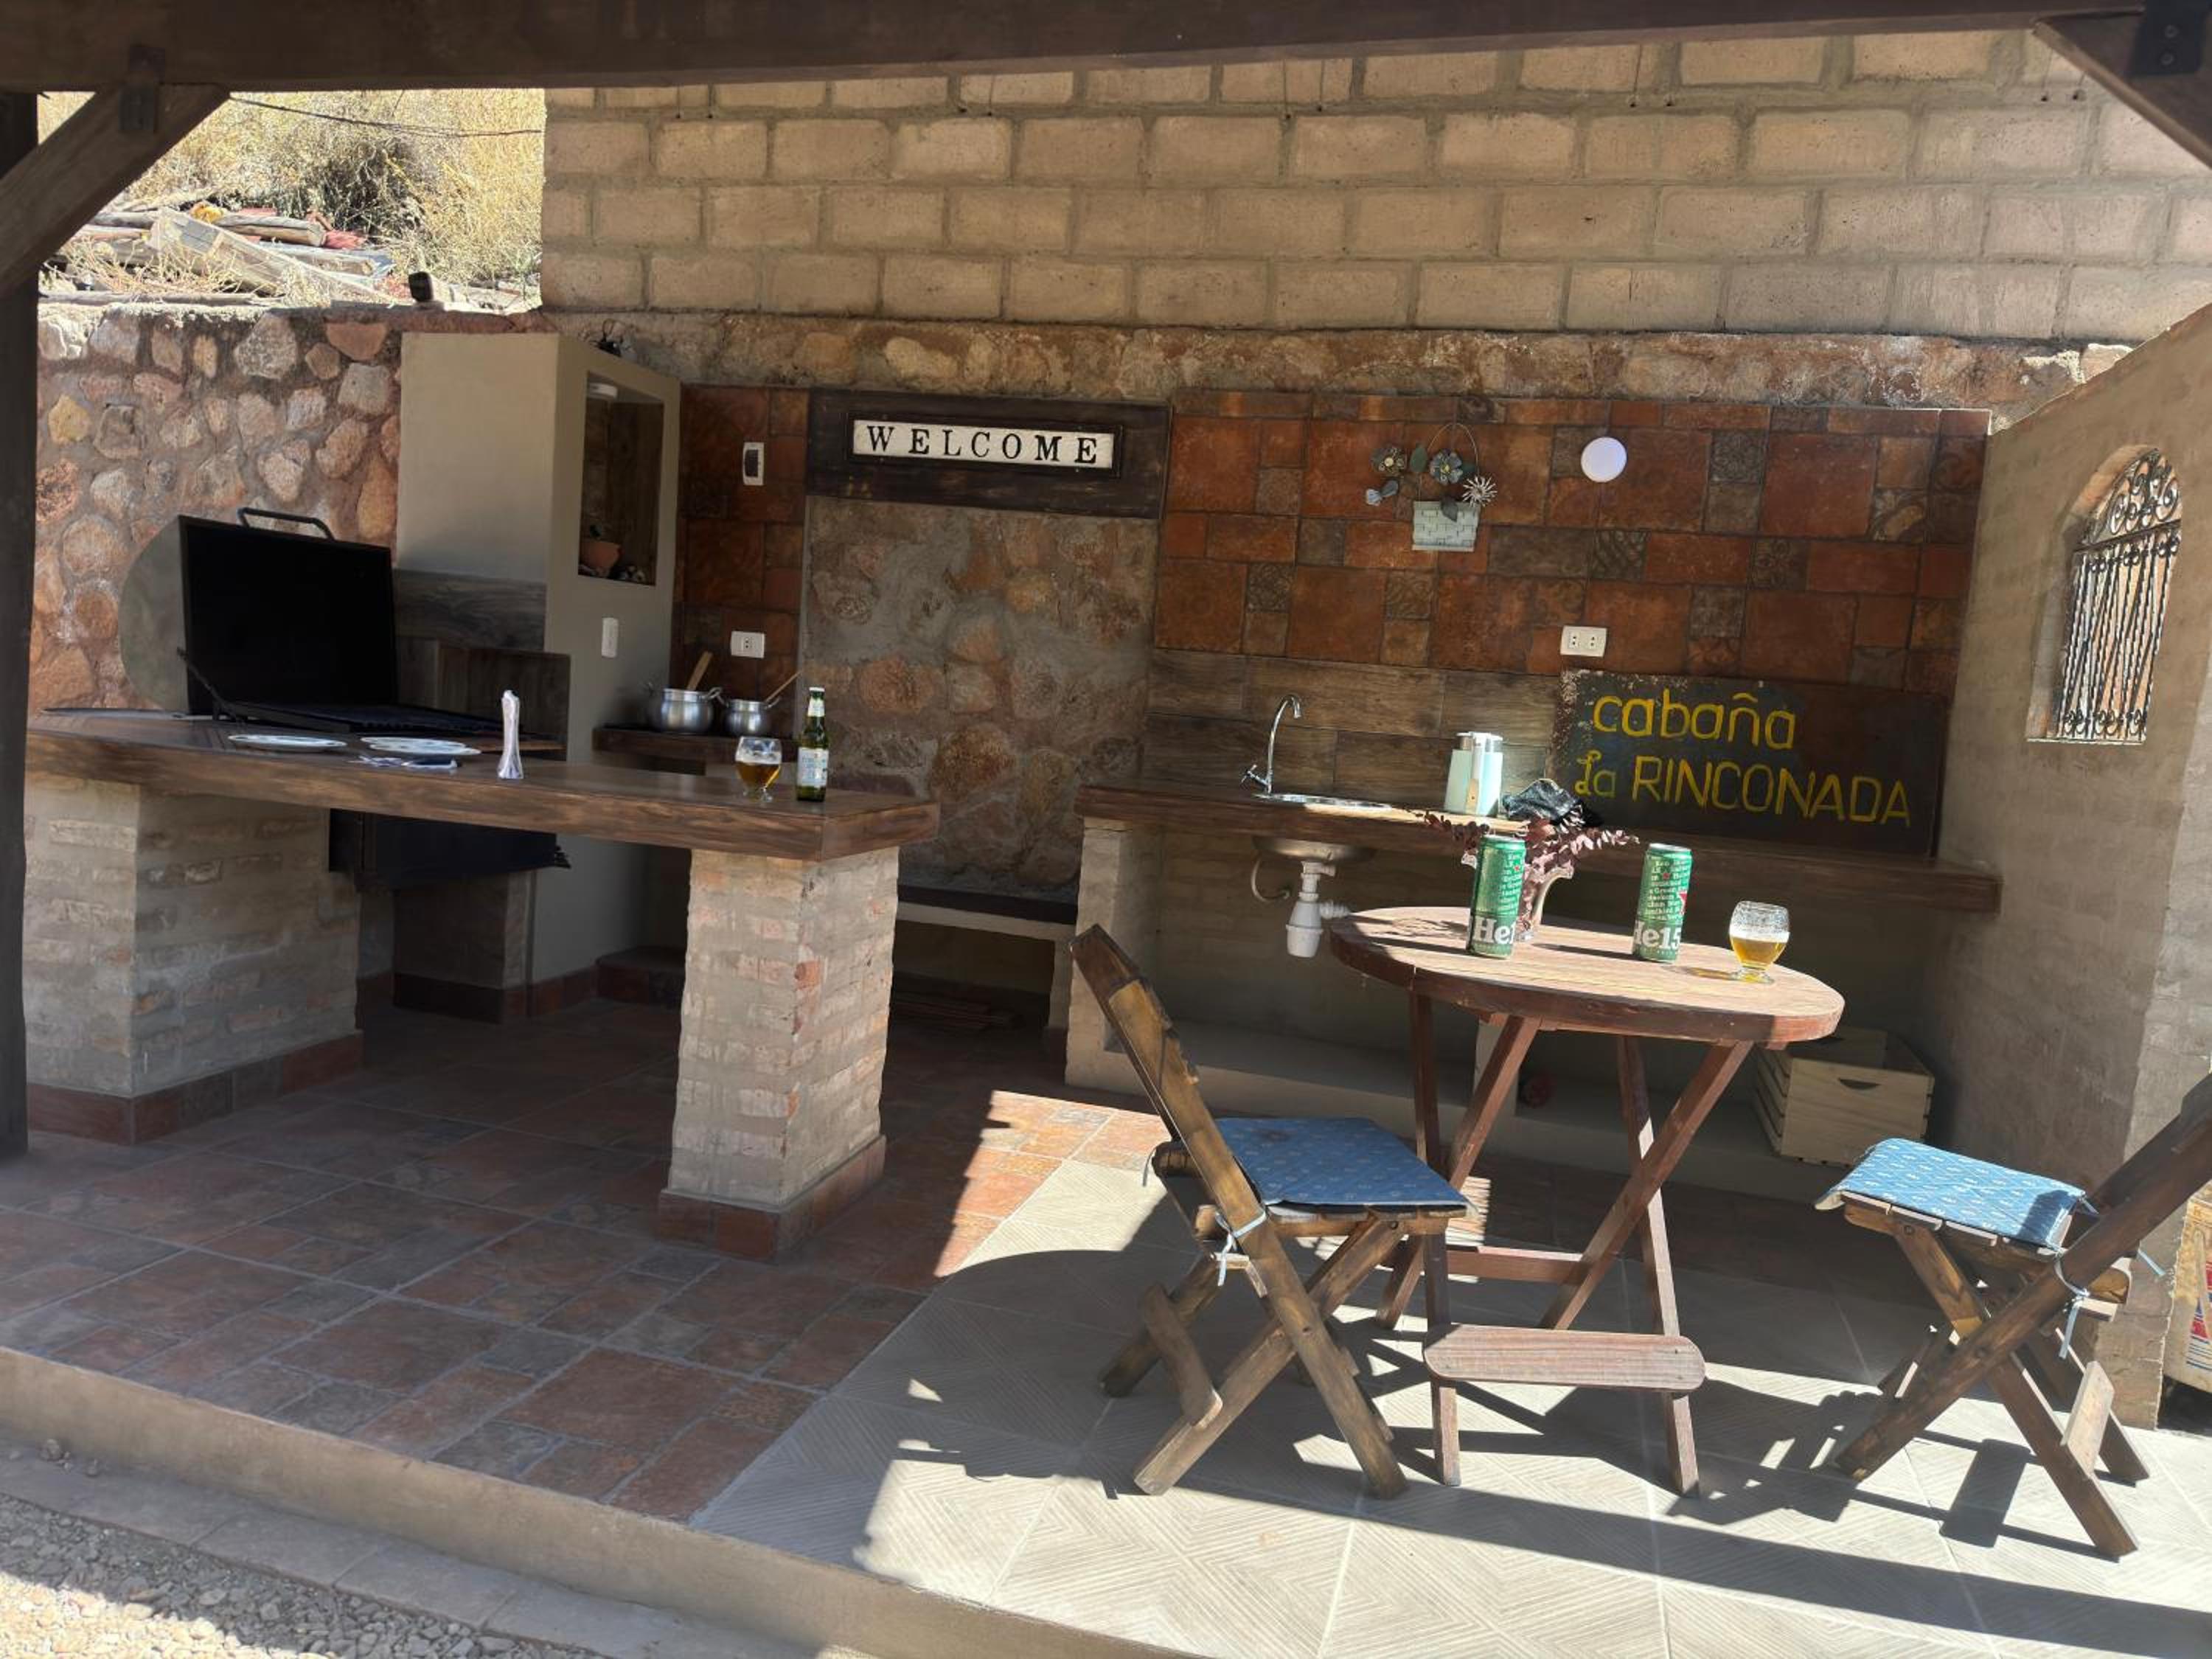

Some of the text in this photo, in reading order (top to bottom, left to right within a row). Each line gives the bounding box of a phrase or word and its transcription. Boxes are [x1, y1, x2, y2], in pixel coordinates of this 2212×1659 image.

[866, 425, 1098, 465] WELCOME
[1592, 687, 1796, 751] cabaña
[1631, 755, 1911, 827] RINCONADA
